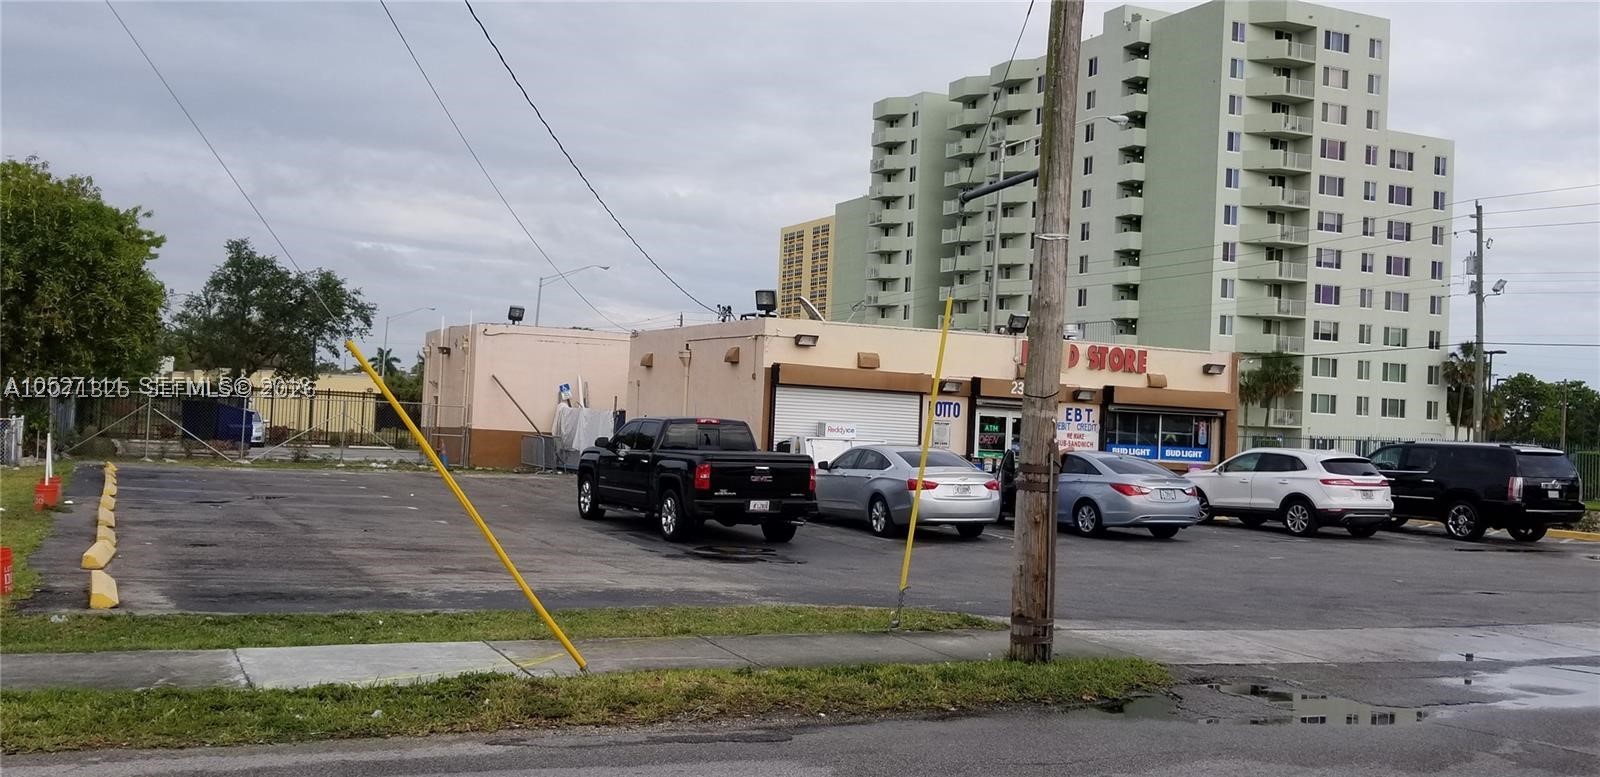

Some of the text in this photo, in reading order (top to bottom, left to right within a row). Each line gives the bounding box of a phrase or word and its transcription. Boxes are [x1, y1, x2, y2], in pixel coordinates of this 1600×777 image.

[1087, 345, 1148, 374] STORE
[928, 400, 961, 418] OTTO
[984, 424, 999, 432] ATM
[979, 434, 1000, 445] OPEN
[1112, 447, 1151, 457] BUD LIGHT
[1165, 449, 1203, 459] BUD LIGHT
